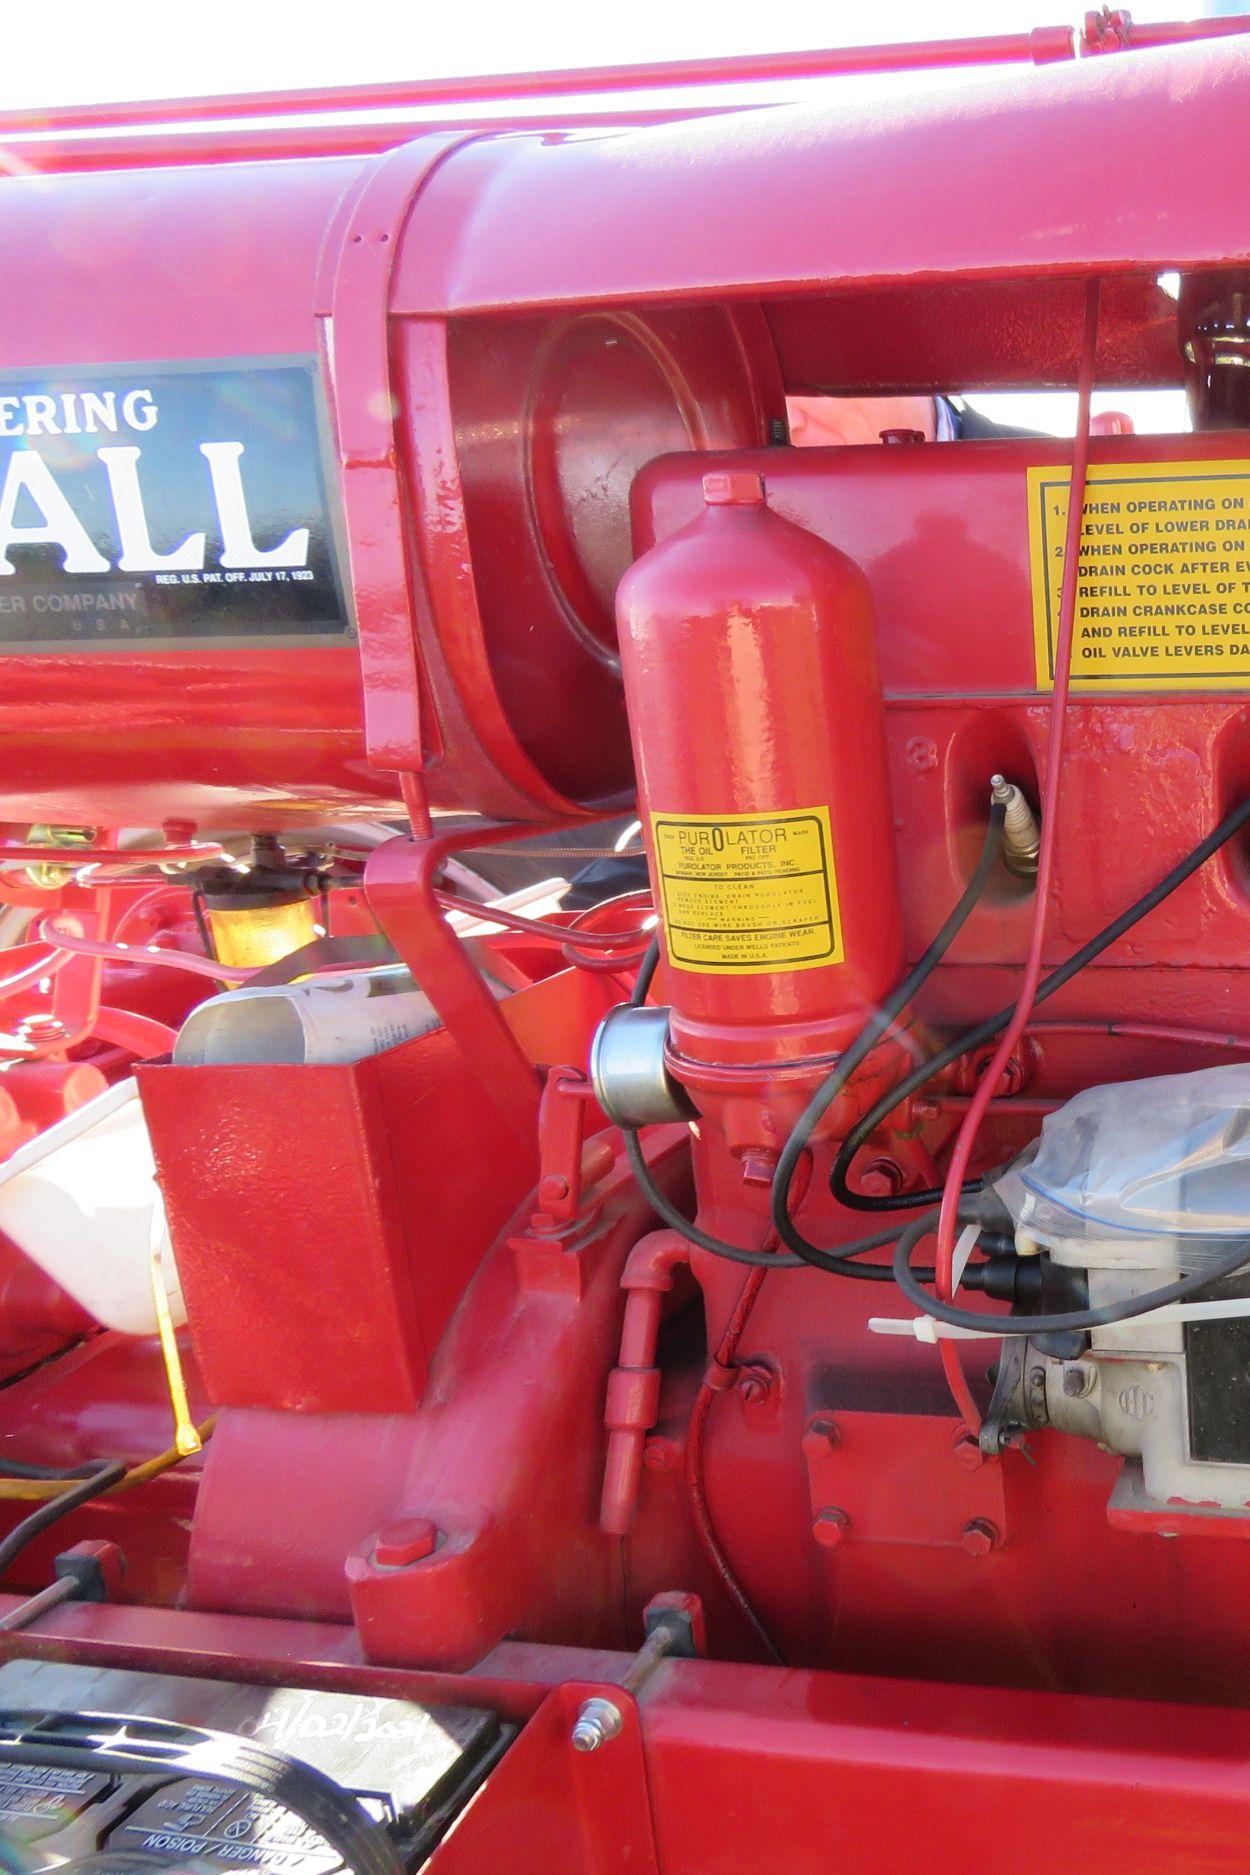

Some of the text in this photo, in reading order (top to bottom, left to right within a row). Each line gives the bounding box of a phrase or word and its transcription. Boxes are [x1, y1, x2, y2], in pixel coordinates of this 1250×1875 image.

[1053, 505, 1066, 517] 1.
[1127, 499, 1215, 513] OPERATING
[1221, 498, 1244, 509] ON
[1081, 523, 1124, 536] EVEL
[1130, 522, 1149, 534] OF
[1155, 520, 1209, 533] LOWER
[1078, 544, 1122, 557] WHEN
[1128, 541, 1216, 555] OPERATING
[1223, 540, 1244, 552] ON
[1079, 565, 1125, 577] DRAIN
[1131, 563, 1174, 576] COCK
[1180, 562, 1230, 574] AFTER
[155, 570, 314, 585] REG. U.S. PAT. OFF. JULY 17, 1923
[1079, 585, 1131, 598] REFILL
[1136, 584, 1157, 596] TO
[1163, 583, 1211, 595] LEVEL
[1216, 582, 1236, 594] OF
[32, 592, 139, 612] COMPANY
[1080, 606, 1127, 618] DRAIN
[1132, 603, 1227, 616] CRANKCASE
[1081, 627, 1112, 638] AND
[1118, 625, 1170, 637] REFILL
[1175, 625, 1196, 636] TO
[1202, 624, 1250, 635] LEVEL
[1082, 647, 1106, 658] OIL
[1112, 646, 1159, 657] VALVE
[1165, 644, 1224, 656] LEVERS
[679, 828, 788, 852] PUROLATOR
[680, 845, 777, 856] THE OIL FILTER
[679, 863, 722, 871] PUROLATOR
[702, 934, 721, 942] CARE
[724, 934, 752, 942] SAVES
[754, 931, 787, 941] ENGINE
[143, 1832, 207, 1856] POISON
